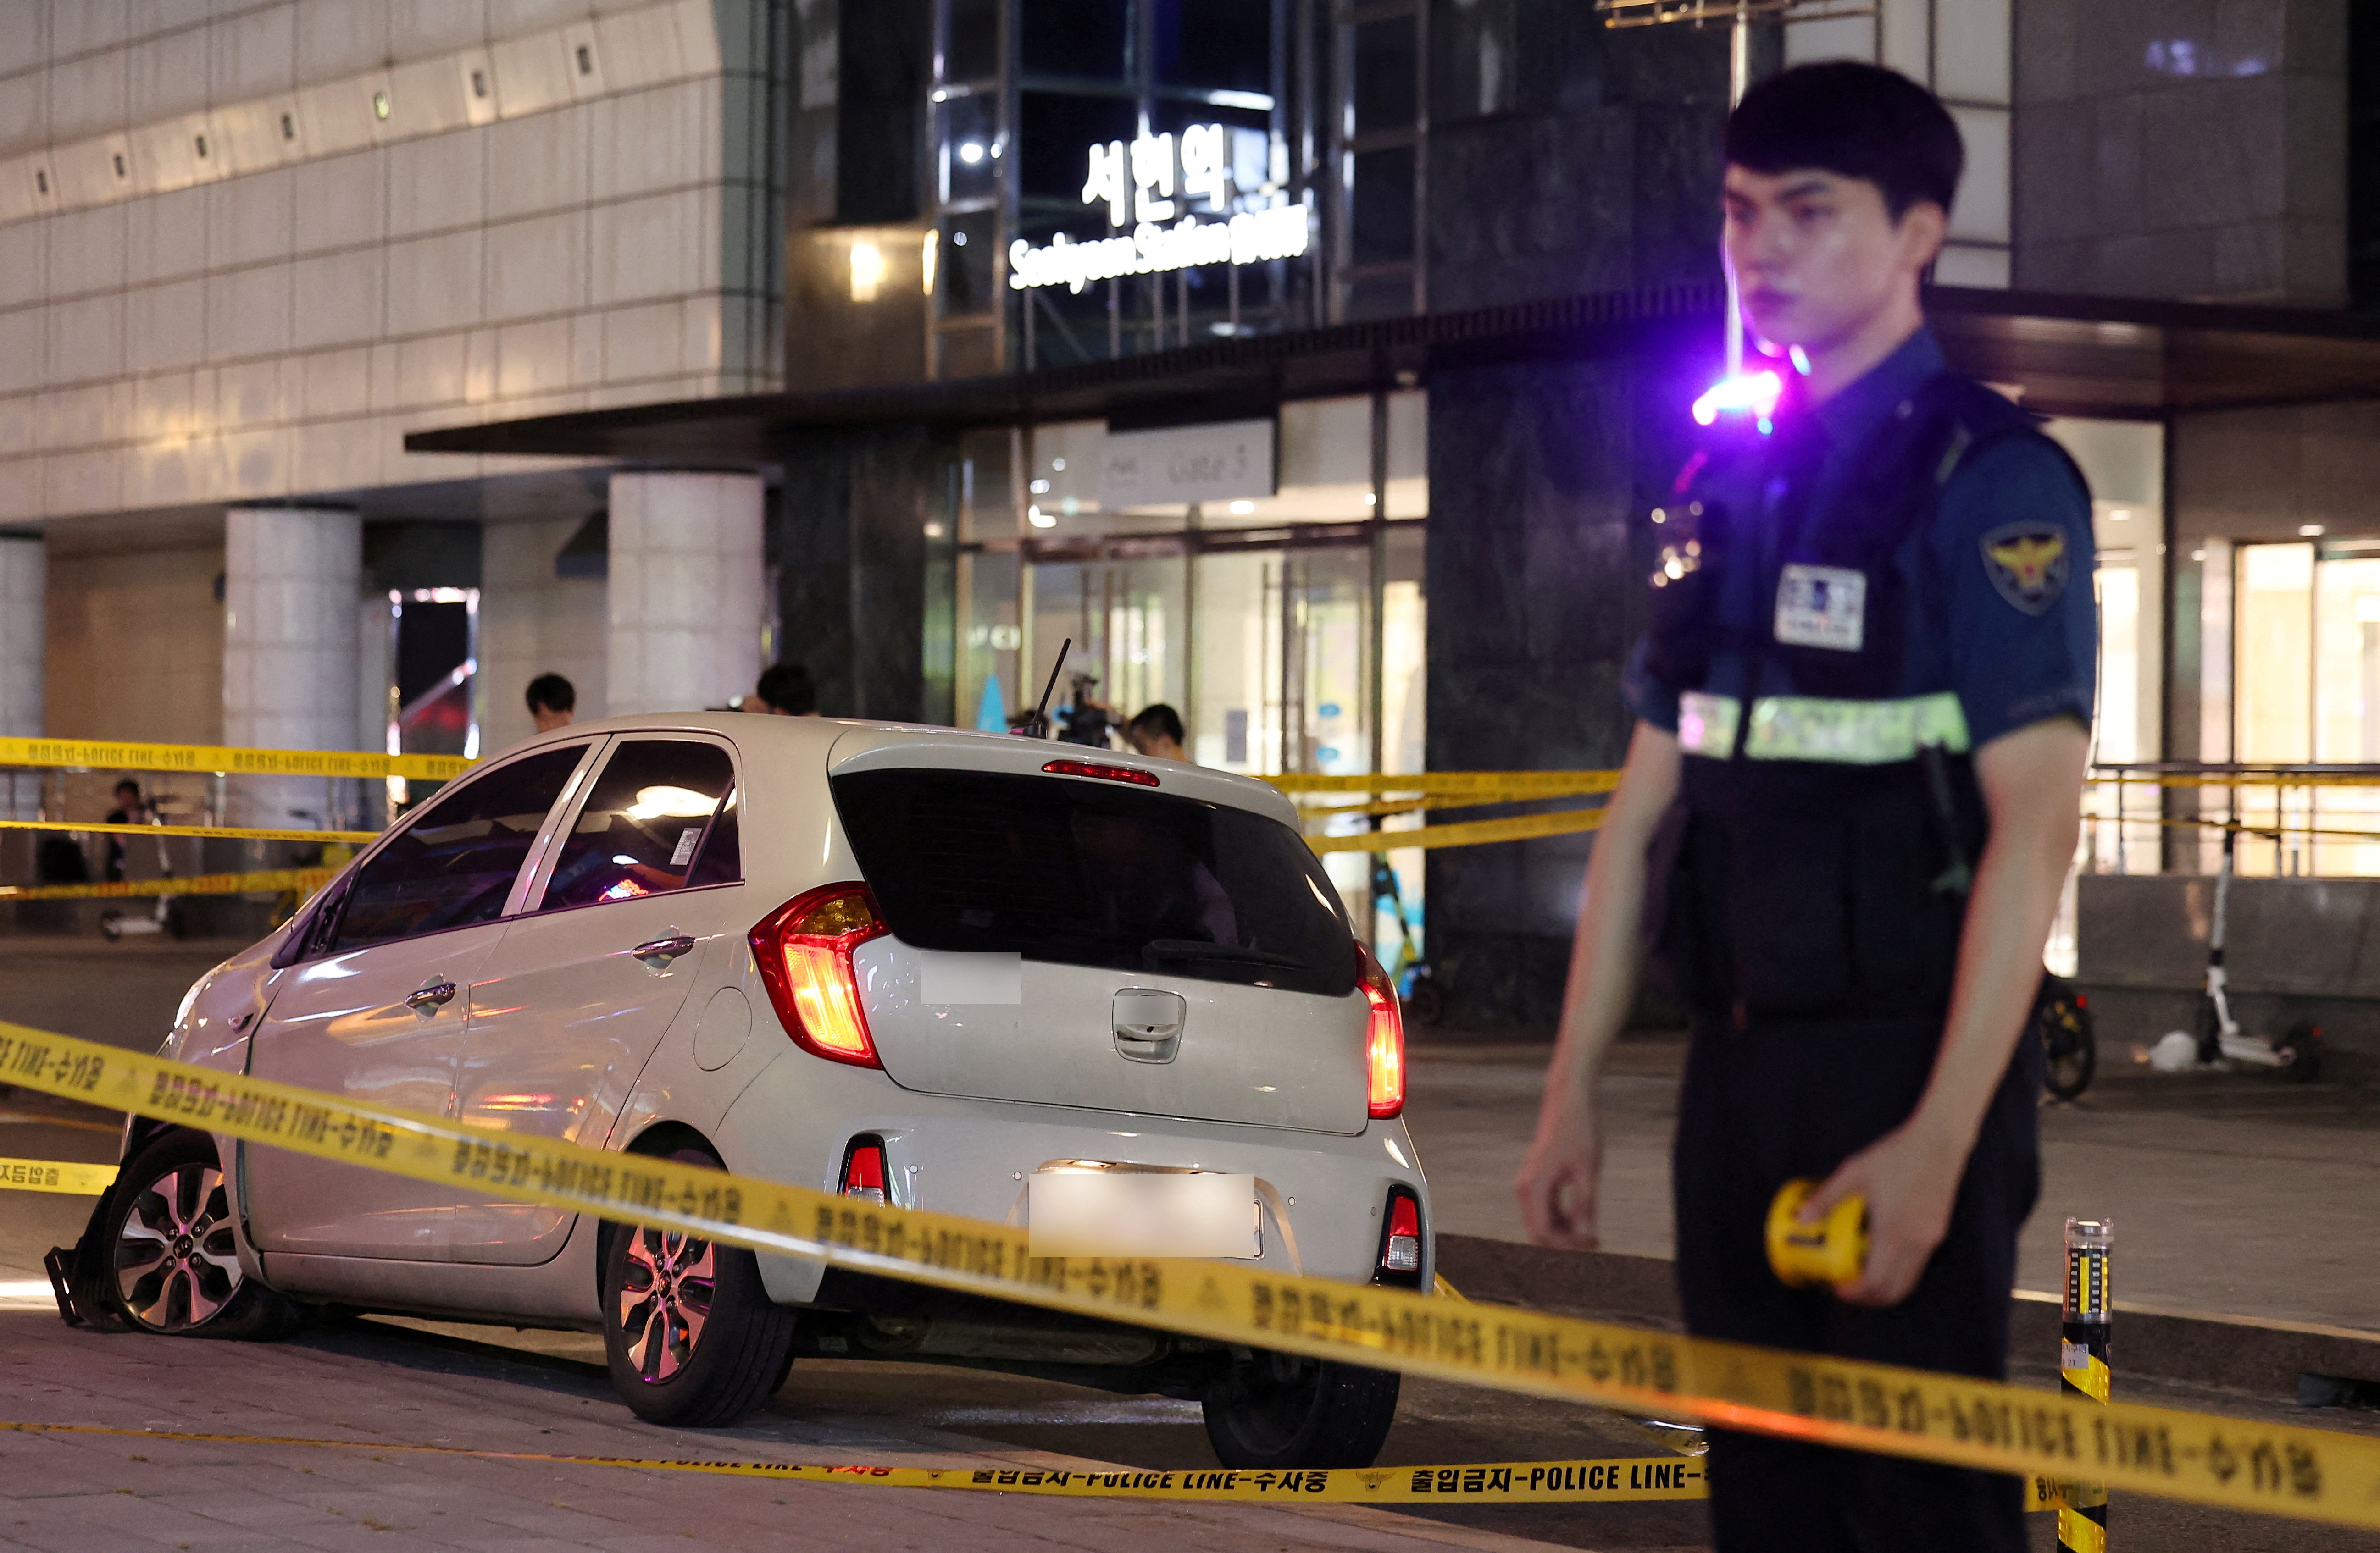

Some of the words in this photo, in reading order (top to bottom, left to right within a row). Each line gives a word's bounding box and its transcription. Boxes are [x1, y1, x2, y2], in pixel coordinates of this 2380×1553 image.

[1082, 123, 1225, 227] 서현역
[1411, 1465, 1620, 1493] 출입금지-POLICE
[1631, 1464, 1709, 1490] LINE-
